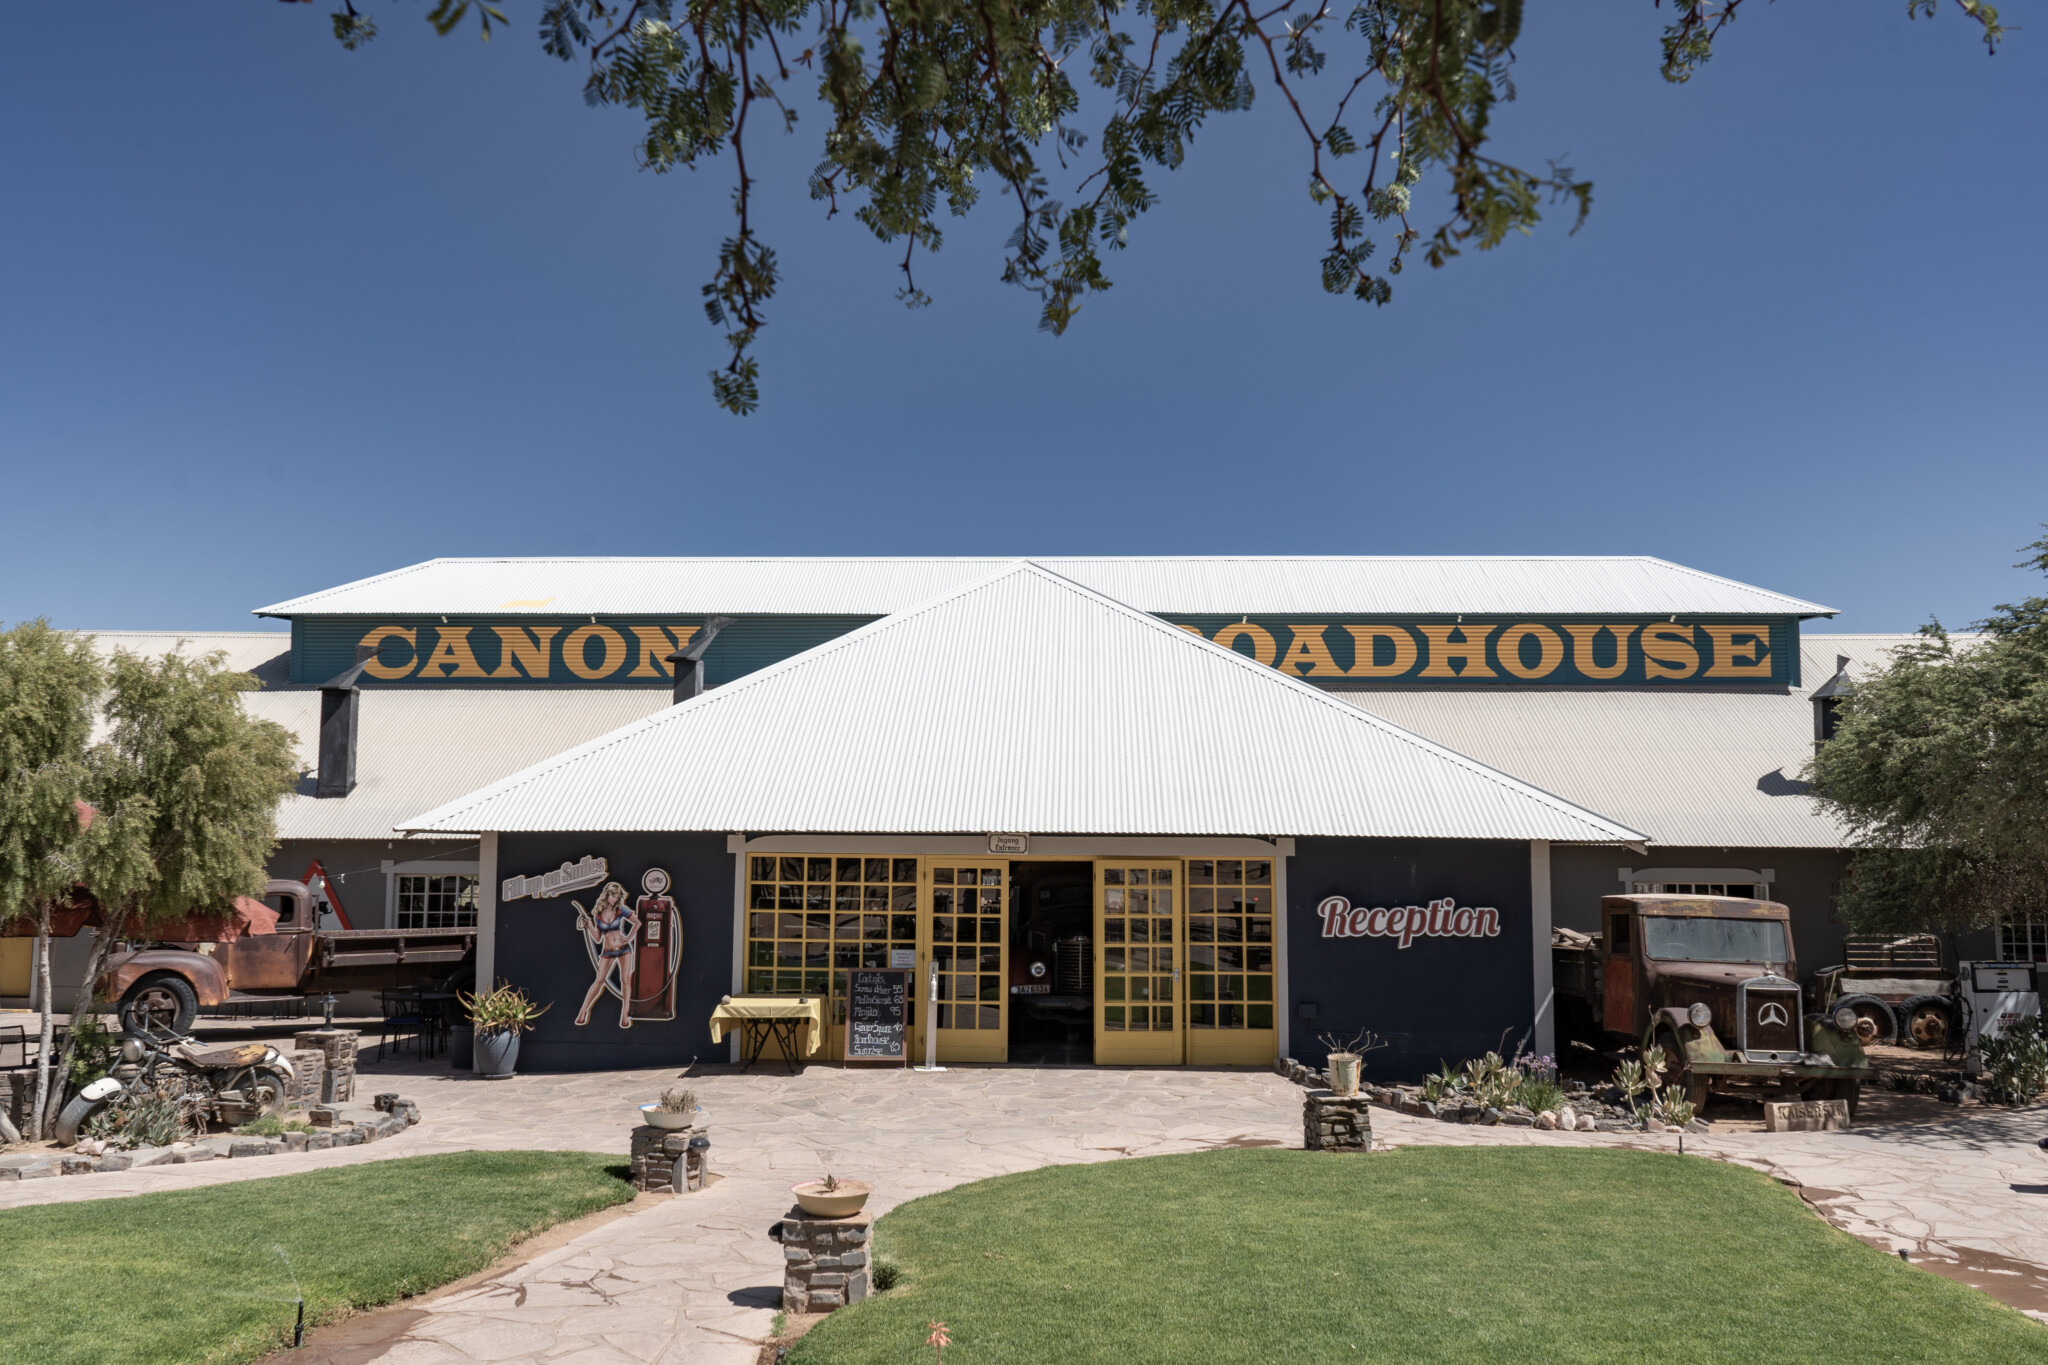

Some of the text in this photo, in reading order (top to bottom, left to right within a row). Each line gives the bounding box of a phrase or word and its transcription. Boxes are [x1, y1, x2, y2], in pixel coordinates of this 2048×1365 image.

[358, 625, 701, 679] CANON
[1175, 622, 1772, 679] OADHOUSE
[503, 855, 606, 900] Fill up on Smiles
[1317, 896, 1501, 949] Reception
[893, 995, 904, 1004] 65
